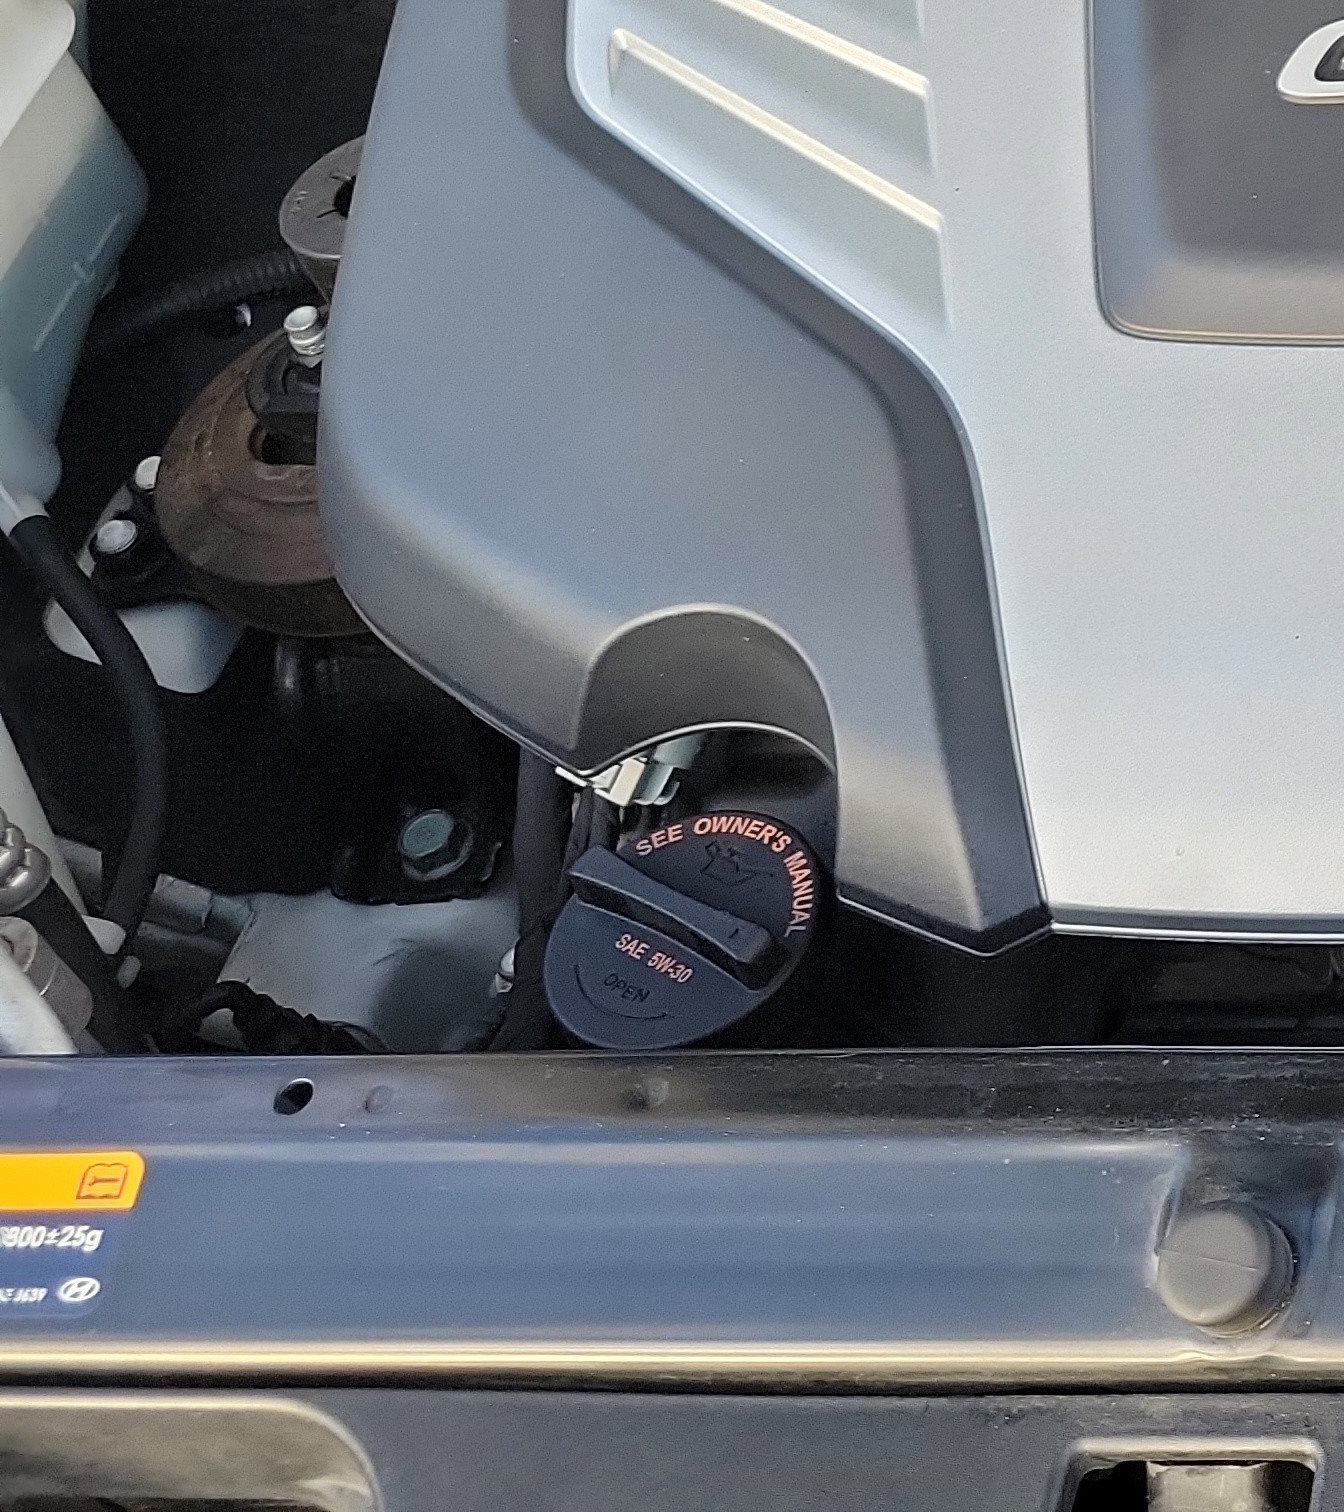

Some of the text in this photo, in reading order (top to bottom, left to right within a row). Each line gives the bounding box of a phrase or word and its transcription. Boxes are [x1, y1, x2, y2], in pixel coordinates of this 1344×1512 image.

[635, 816, 814, 938] SEE OWNER'S MANUAL
[615, 933, 694, 983] SAE 5W-30
[603, 973, 651, 1002] OPEN
